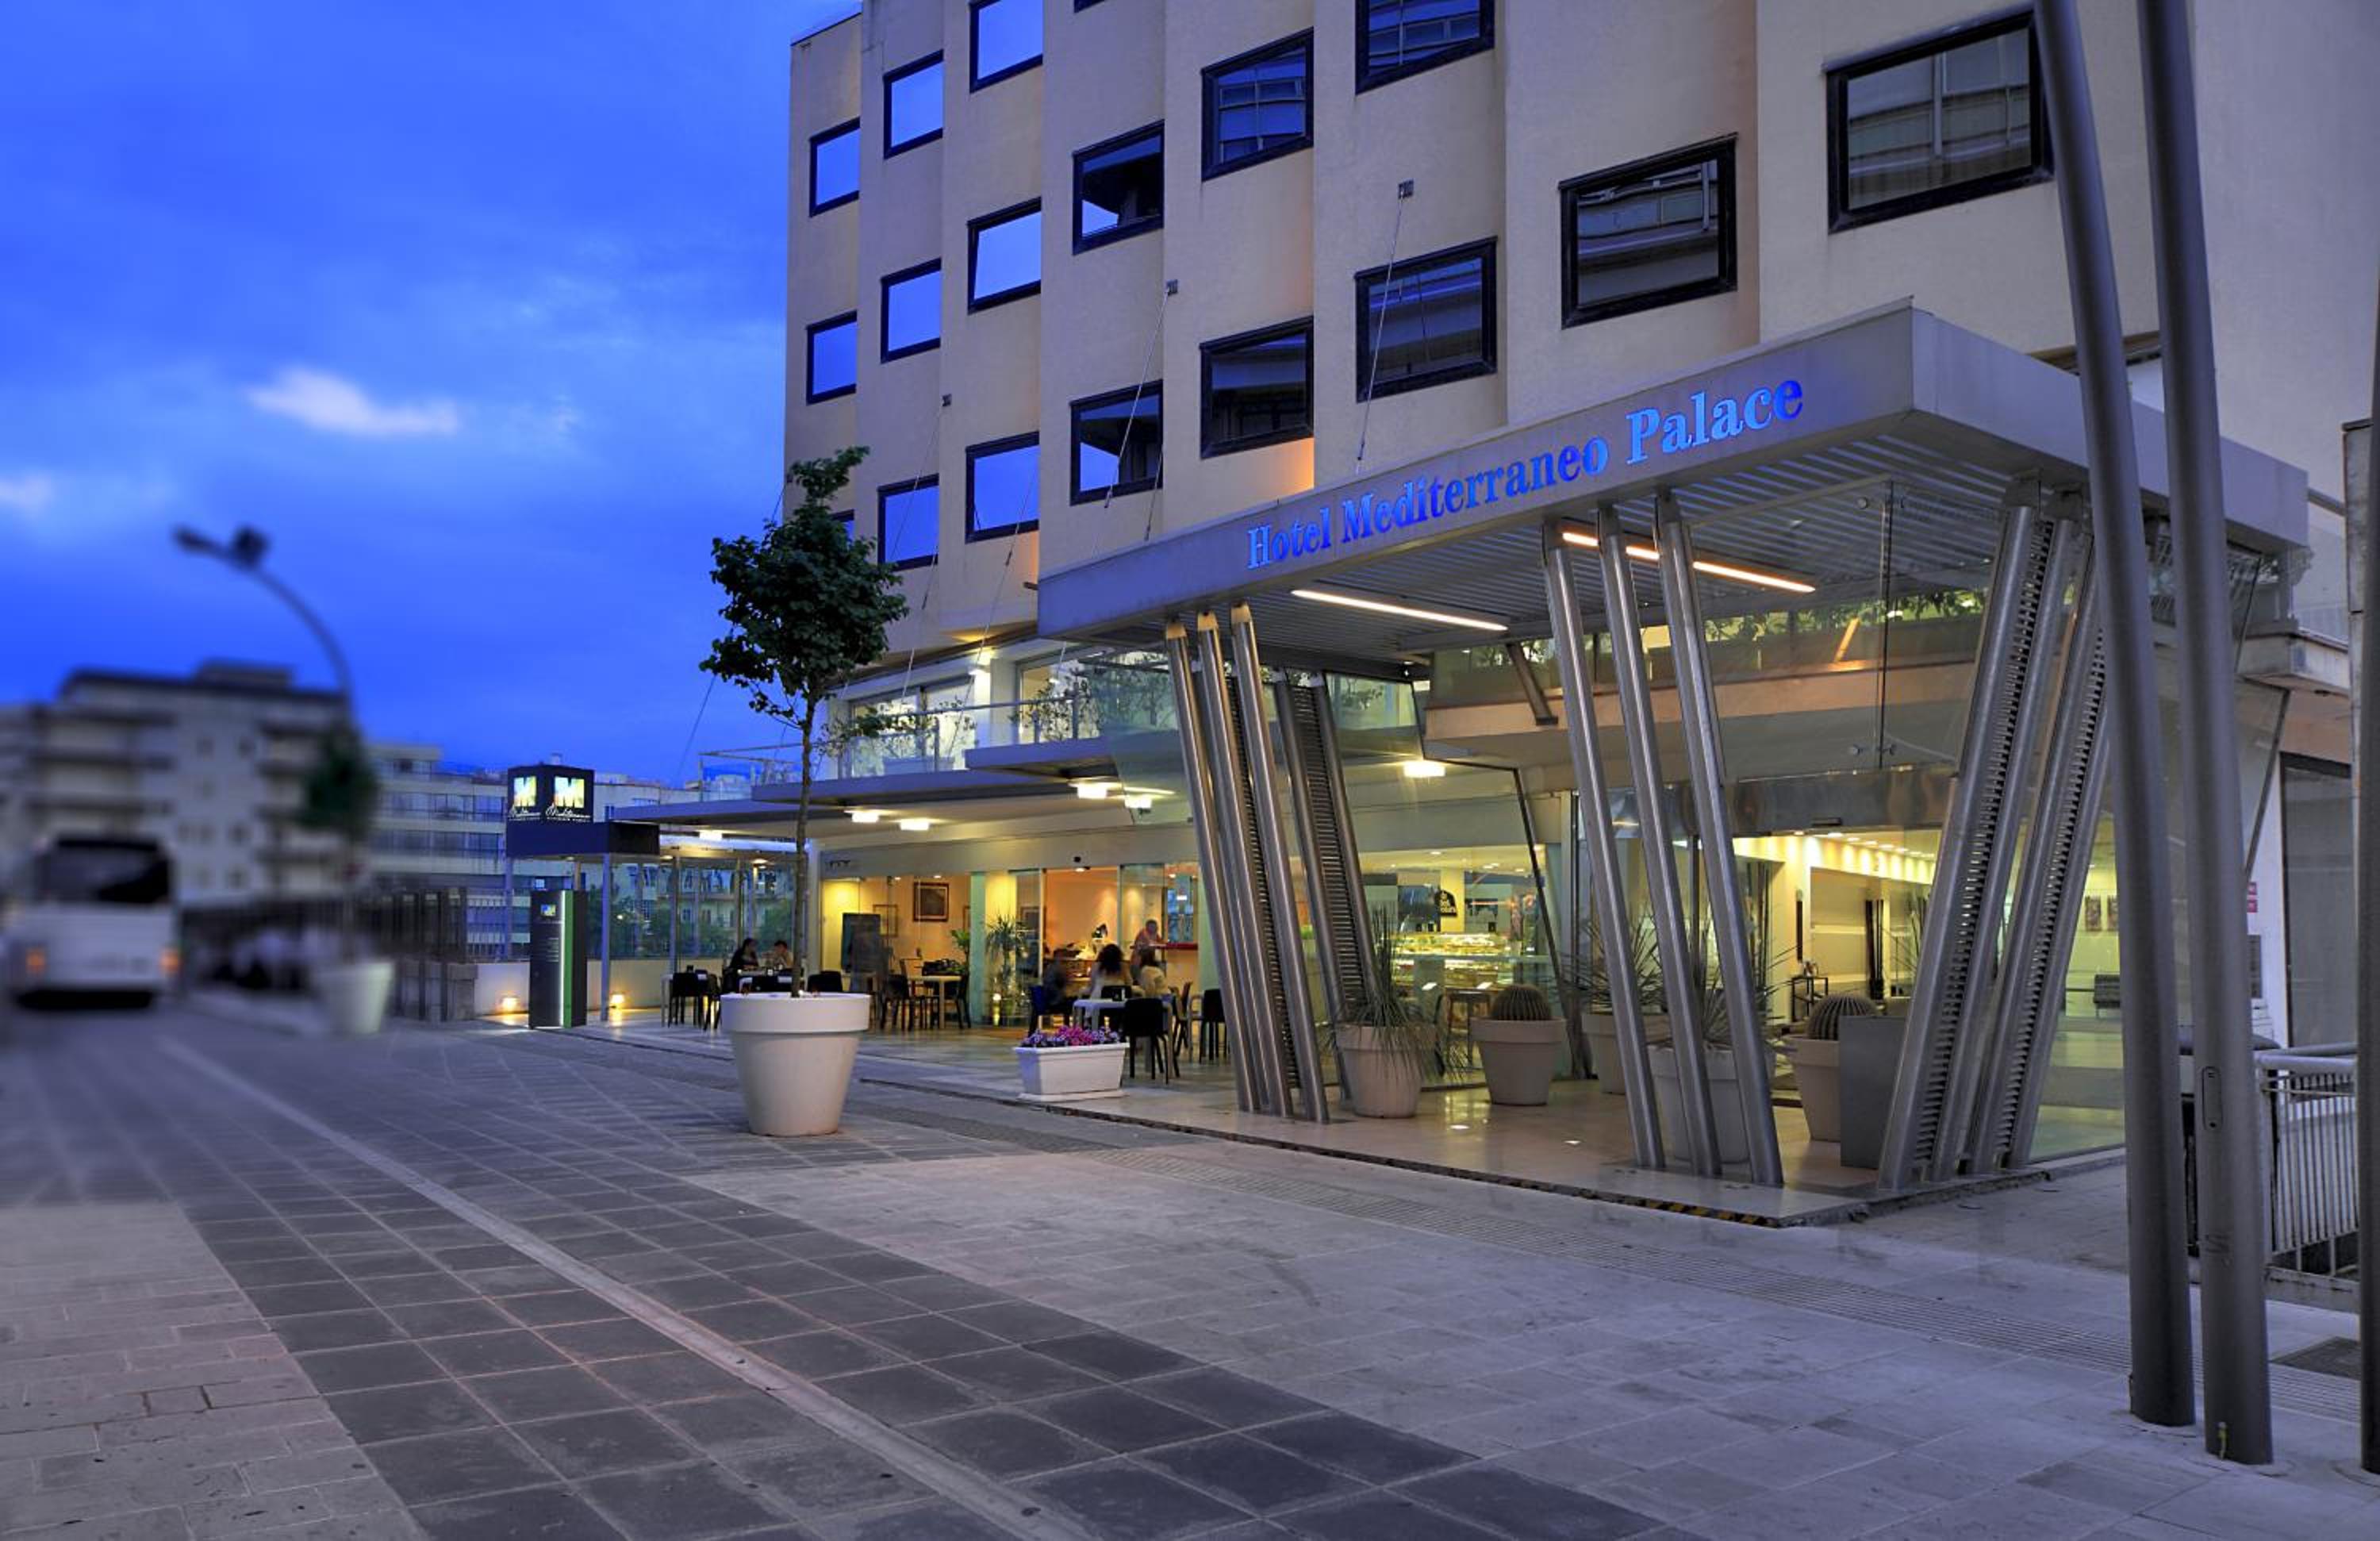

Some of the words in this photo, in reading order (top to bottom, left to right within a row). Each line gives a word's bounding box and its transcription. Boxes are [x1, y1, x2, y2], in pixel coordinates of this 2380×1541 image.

[1247, 506, 1331, 570] Hotel
[1341, 436, 1609, 544] Mediterraneo
[1626, 380, 1803, 465] Palace
